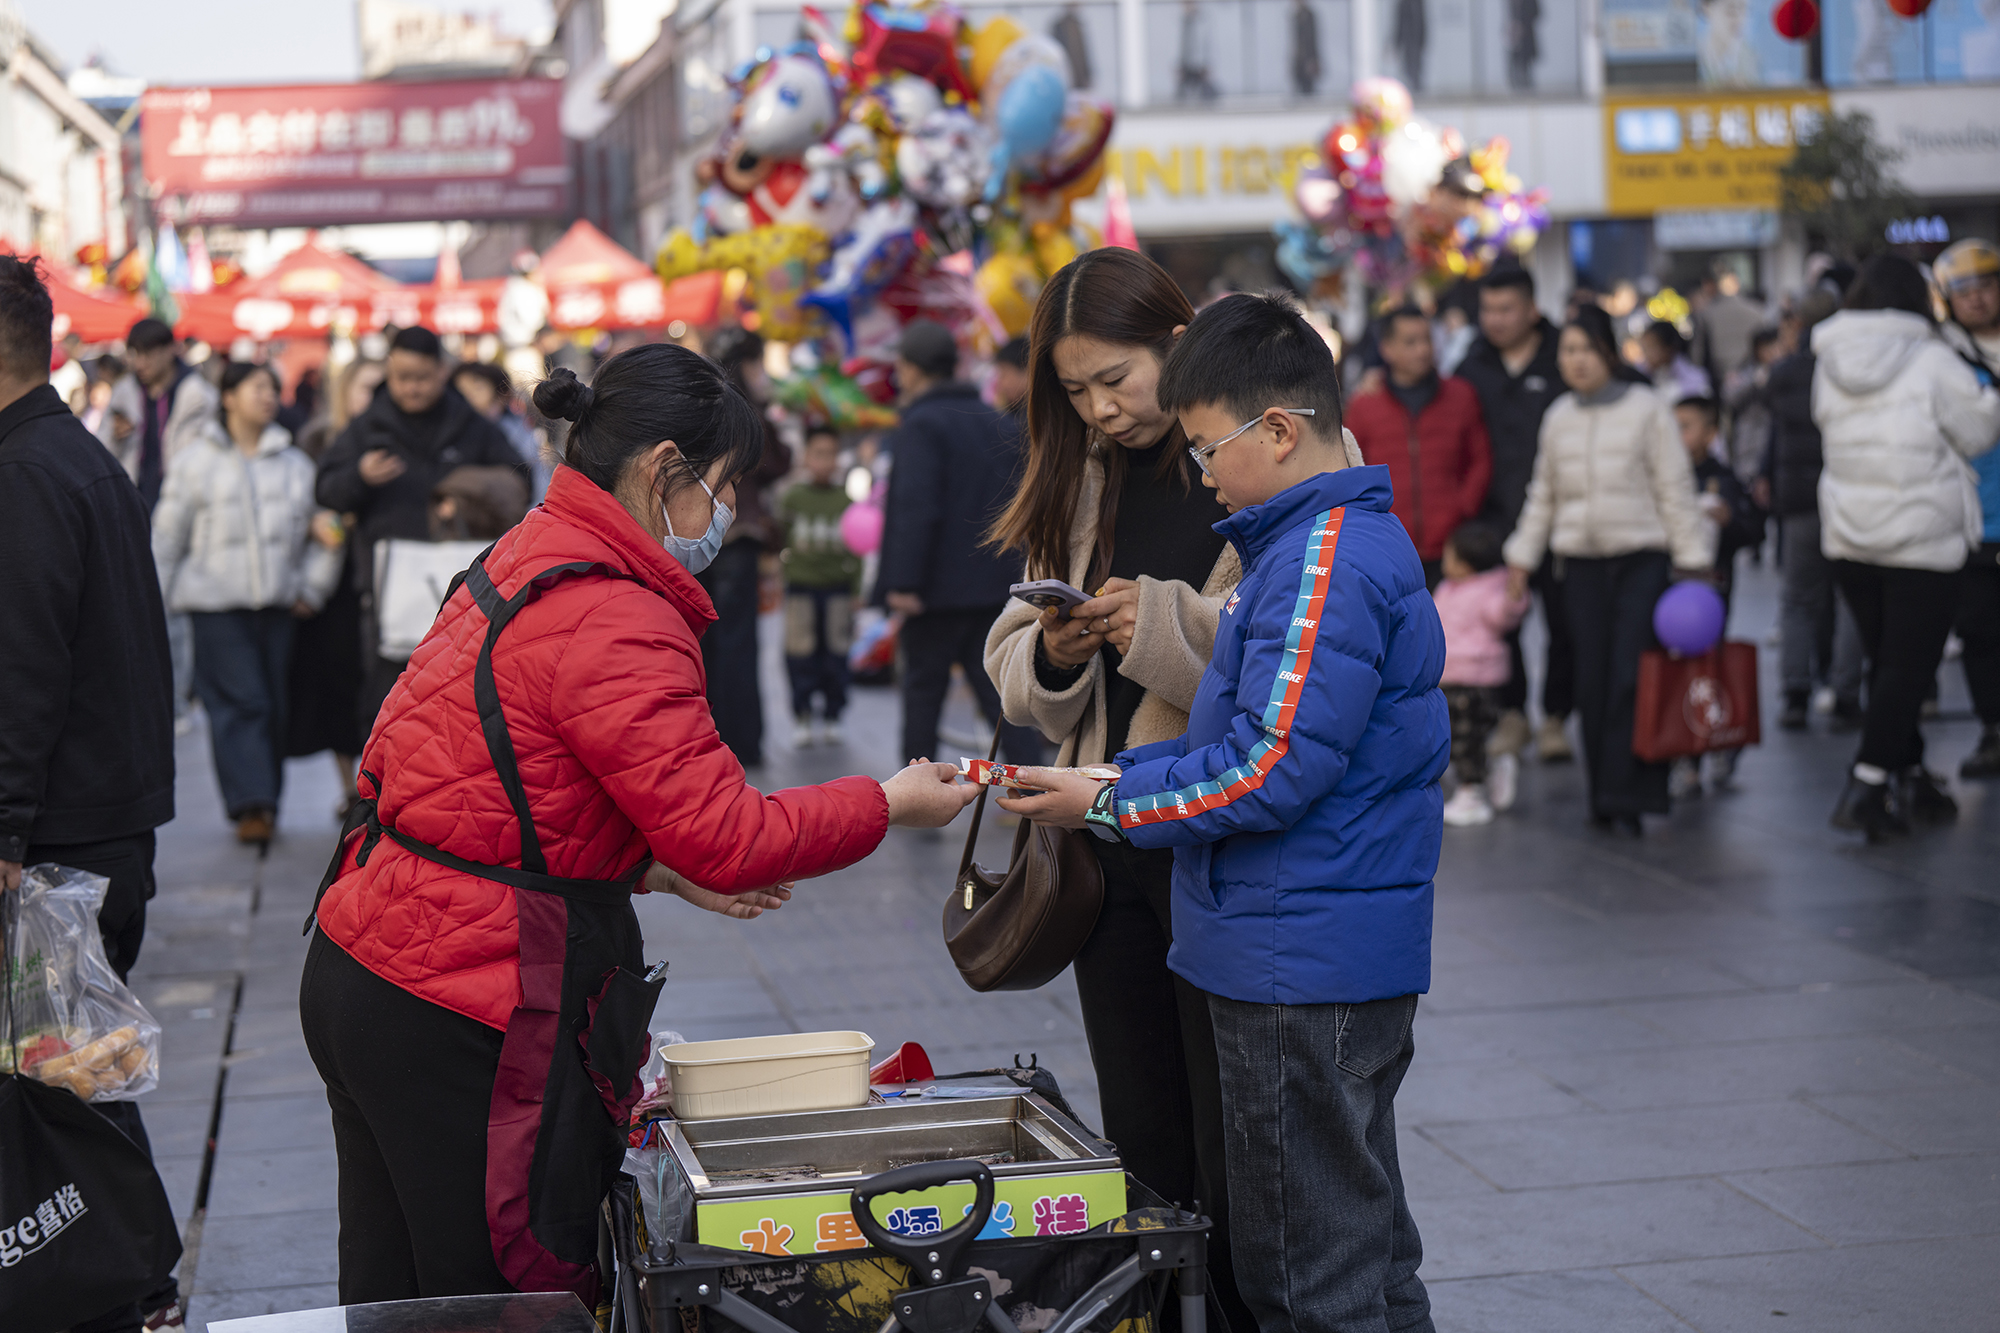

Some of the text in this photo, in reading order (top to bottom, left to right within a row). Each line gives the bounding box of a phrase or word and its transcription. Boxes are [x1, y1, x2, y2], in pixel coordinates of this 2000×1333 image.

[1305, 564, 1329, 576] ERKE
[1292, 617, 1317, 629] ERKE
[1278, 670, 1304, 683] ERKE
[1265, 725, 1287, 739] ERKE
[1248, 759, 1265, 778] ERKE
[1175, 793, 1188, 816] ERKE
[1127, 801, 1141, 824] ERKE
